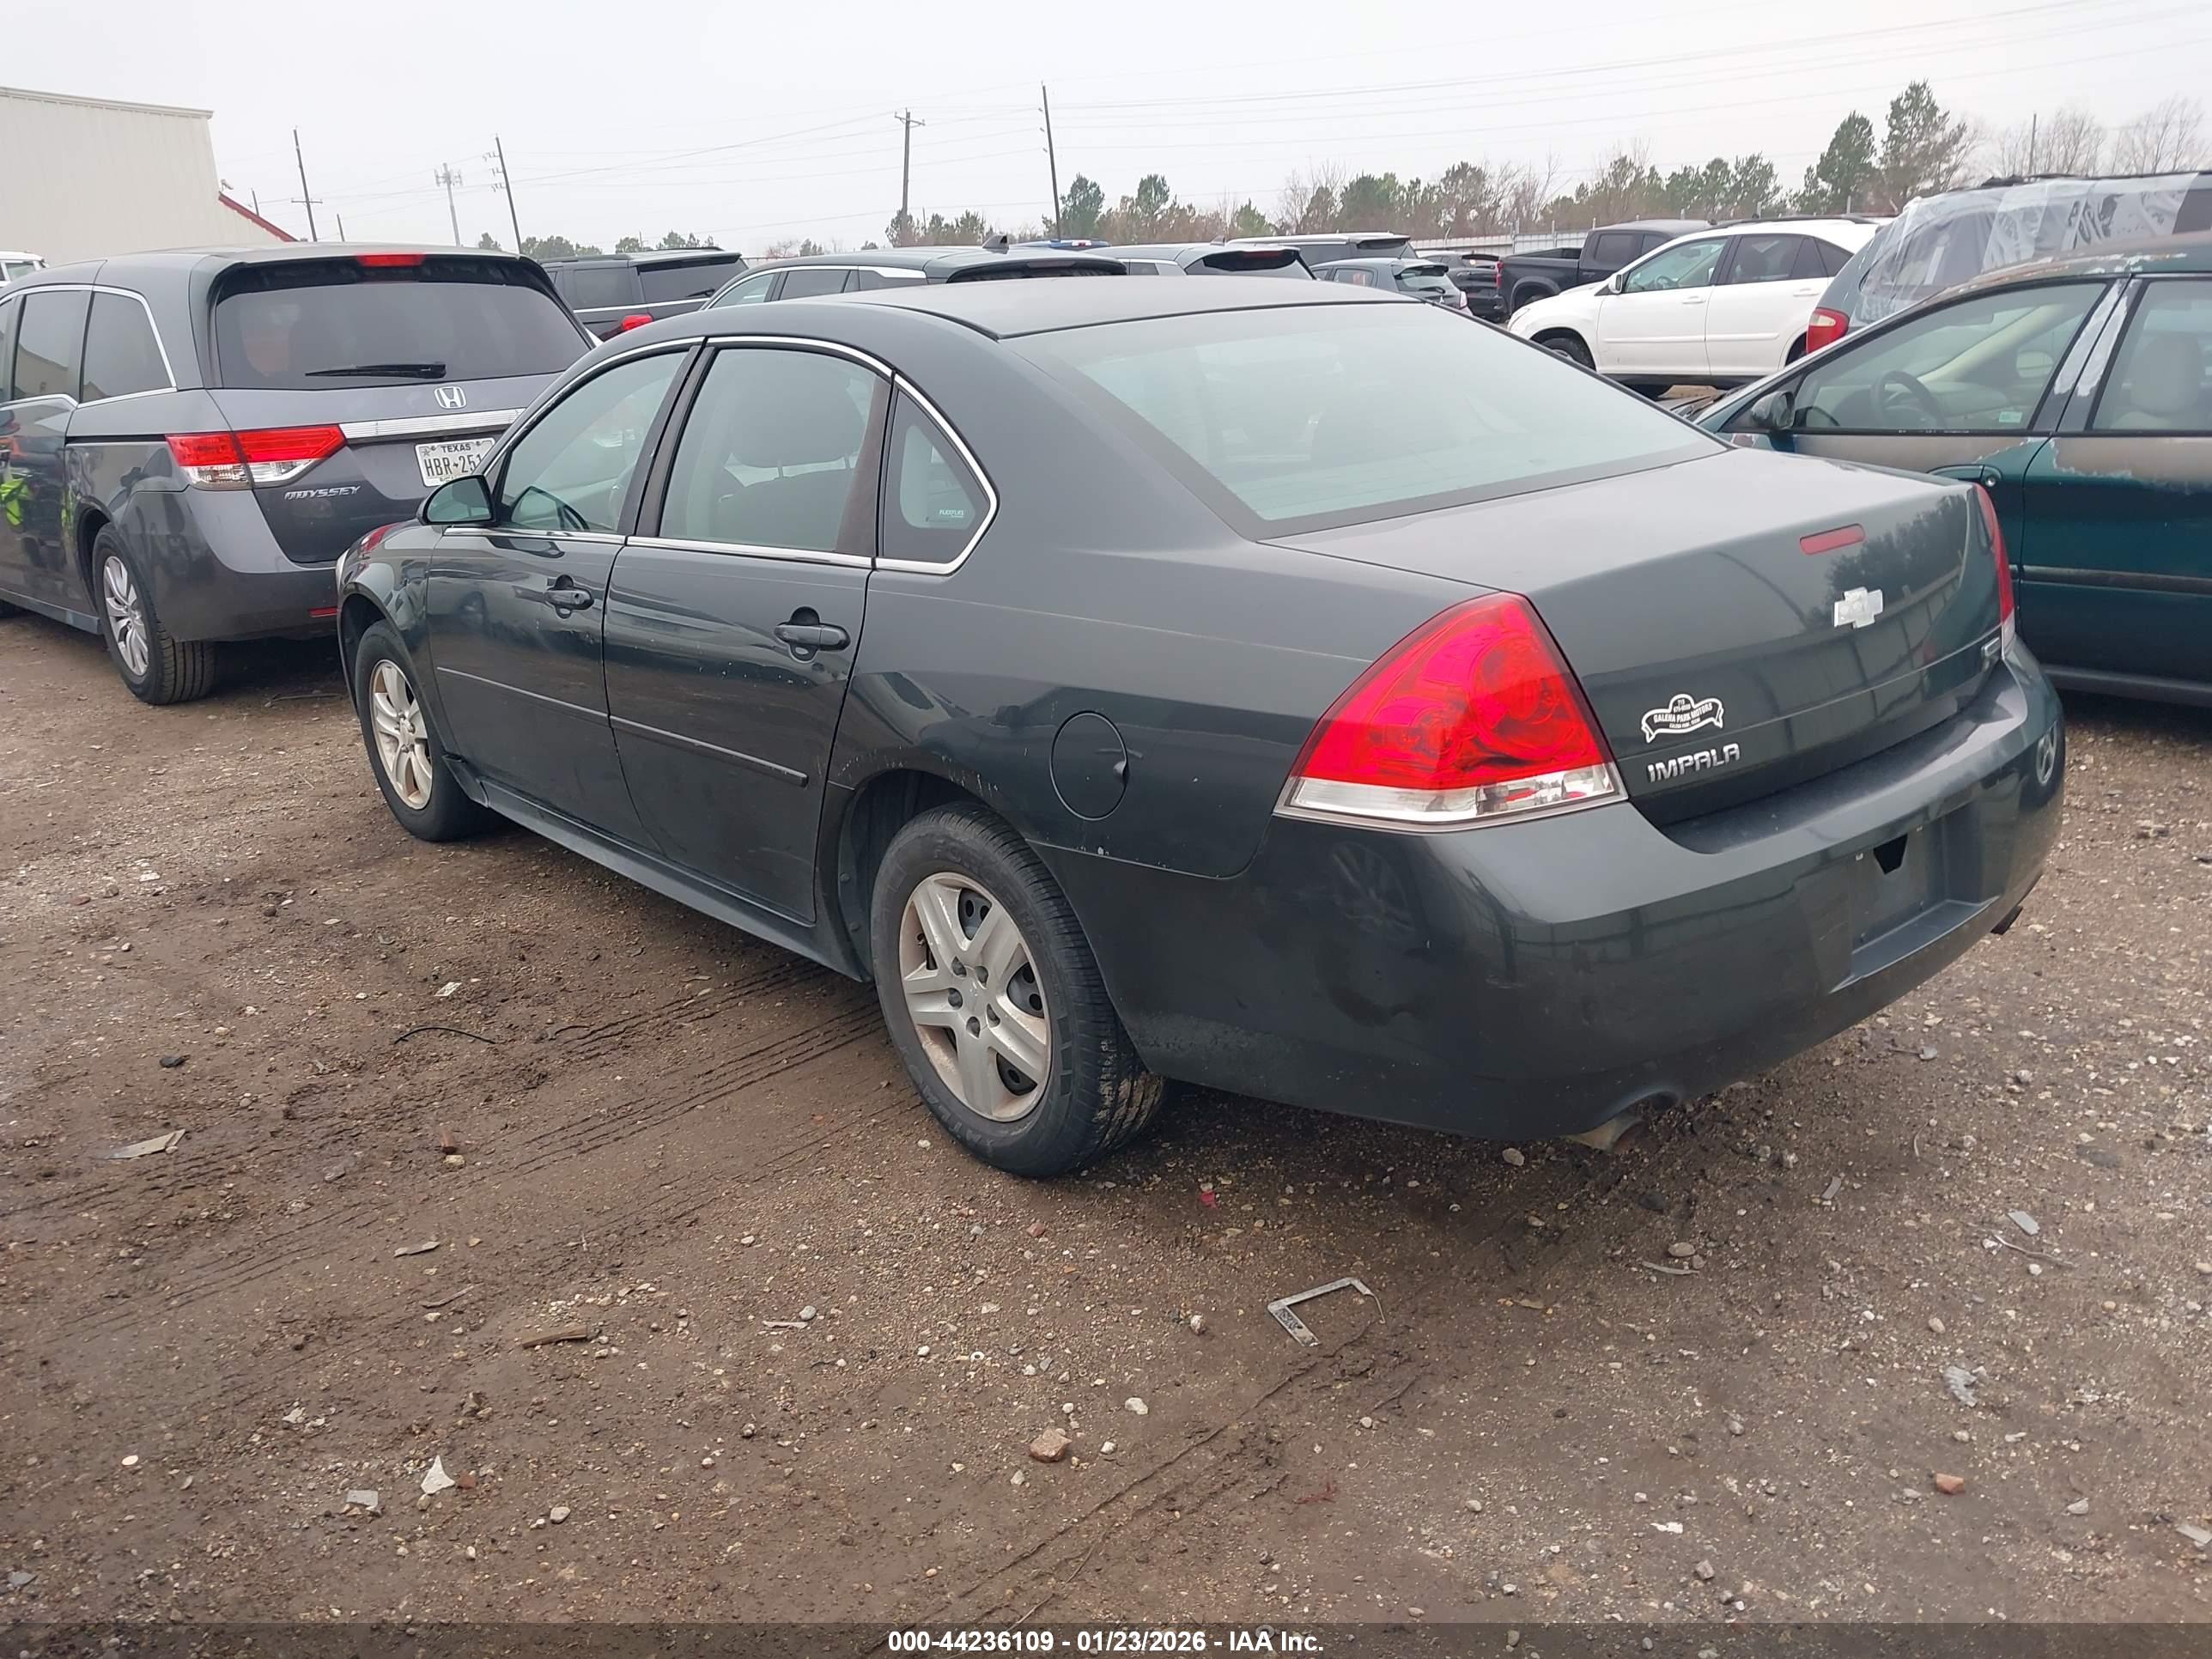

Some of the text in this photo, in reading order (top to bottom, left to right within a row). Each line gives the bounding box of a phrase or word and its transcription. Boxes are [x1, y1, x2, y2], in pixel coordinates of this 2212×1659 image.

[440, 444, 471, 453] TEXAS
[284, 485, 361, 501] ODYSSEY
[1653, 713, 1676, 724] GALENA
[1676, 712, 1692, 723] PARK
[1691, 702, 1712, 717] MOTORS
[1648, 744, 1741, 782] IMPALA
